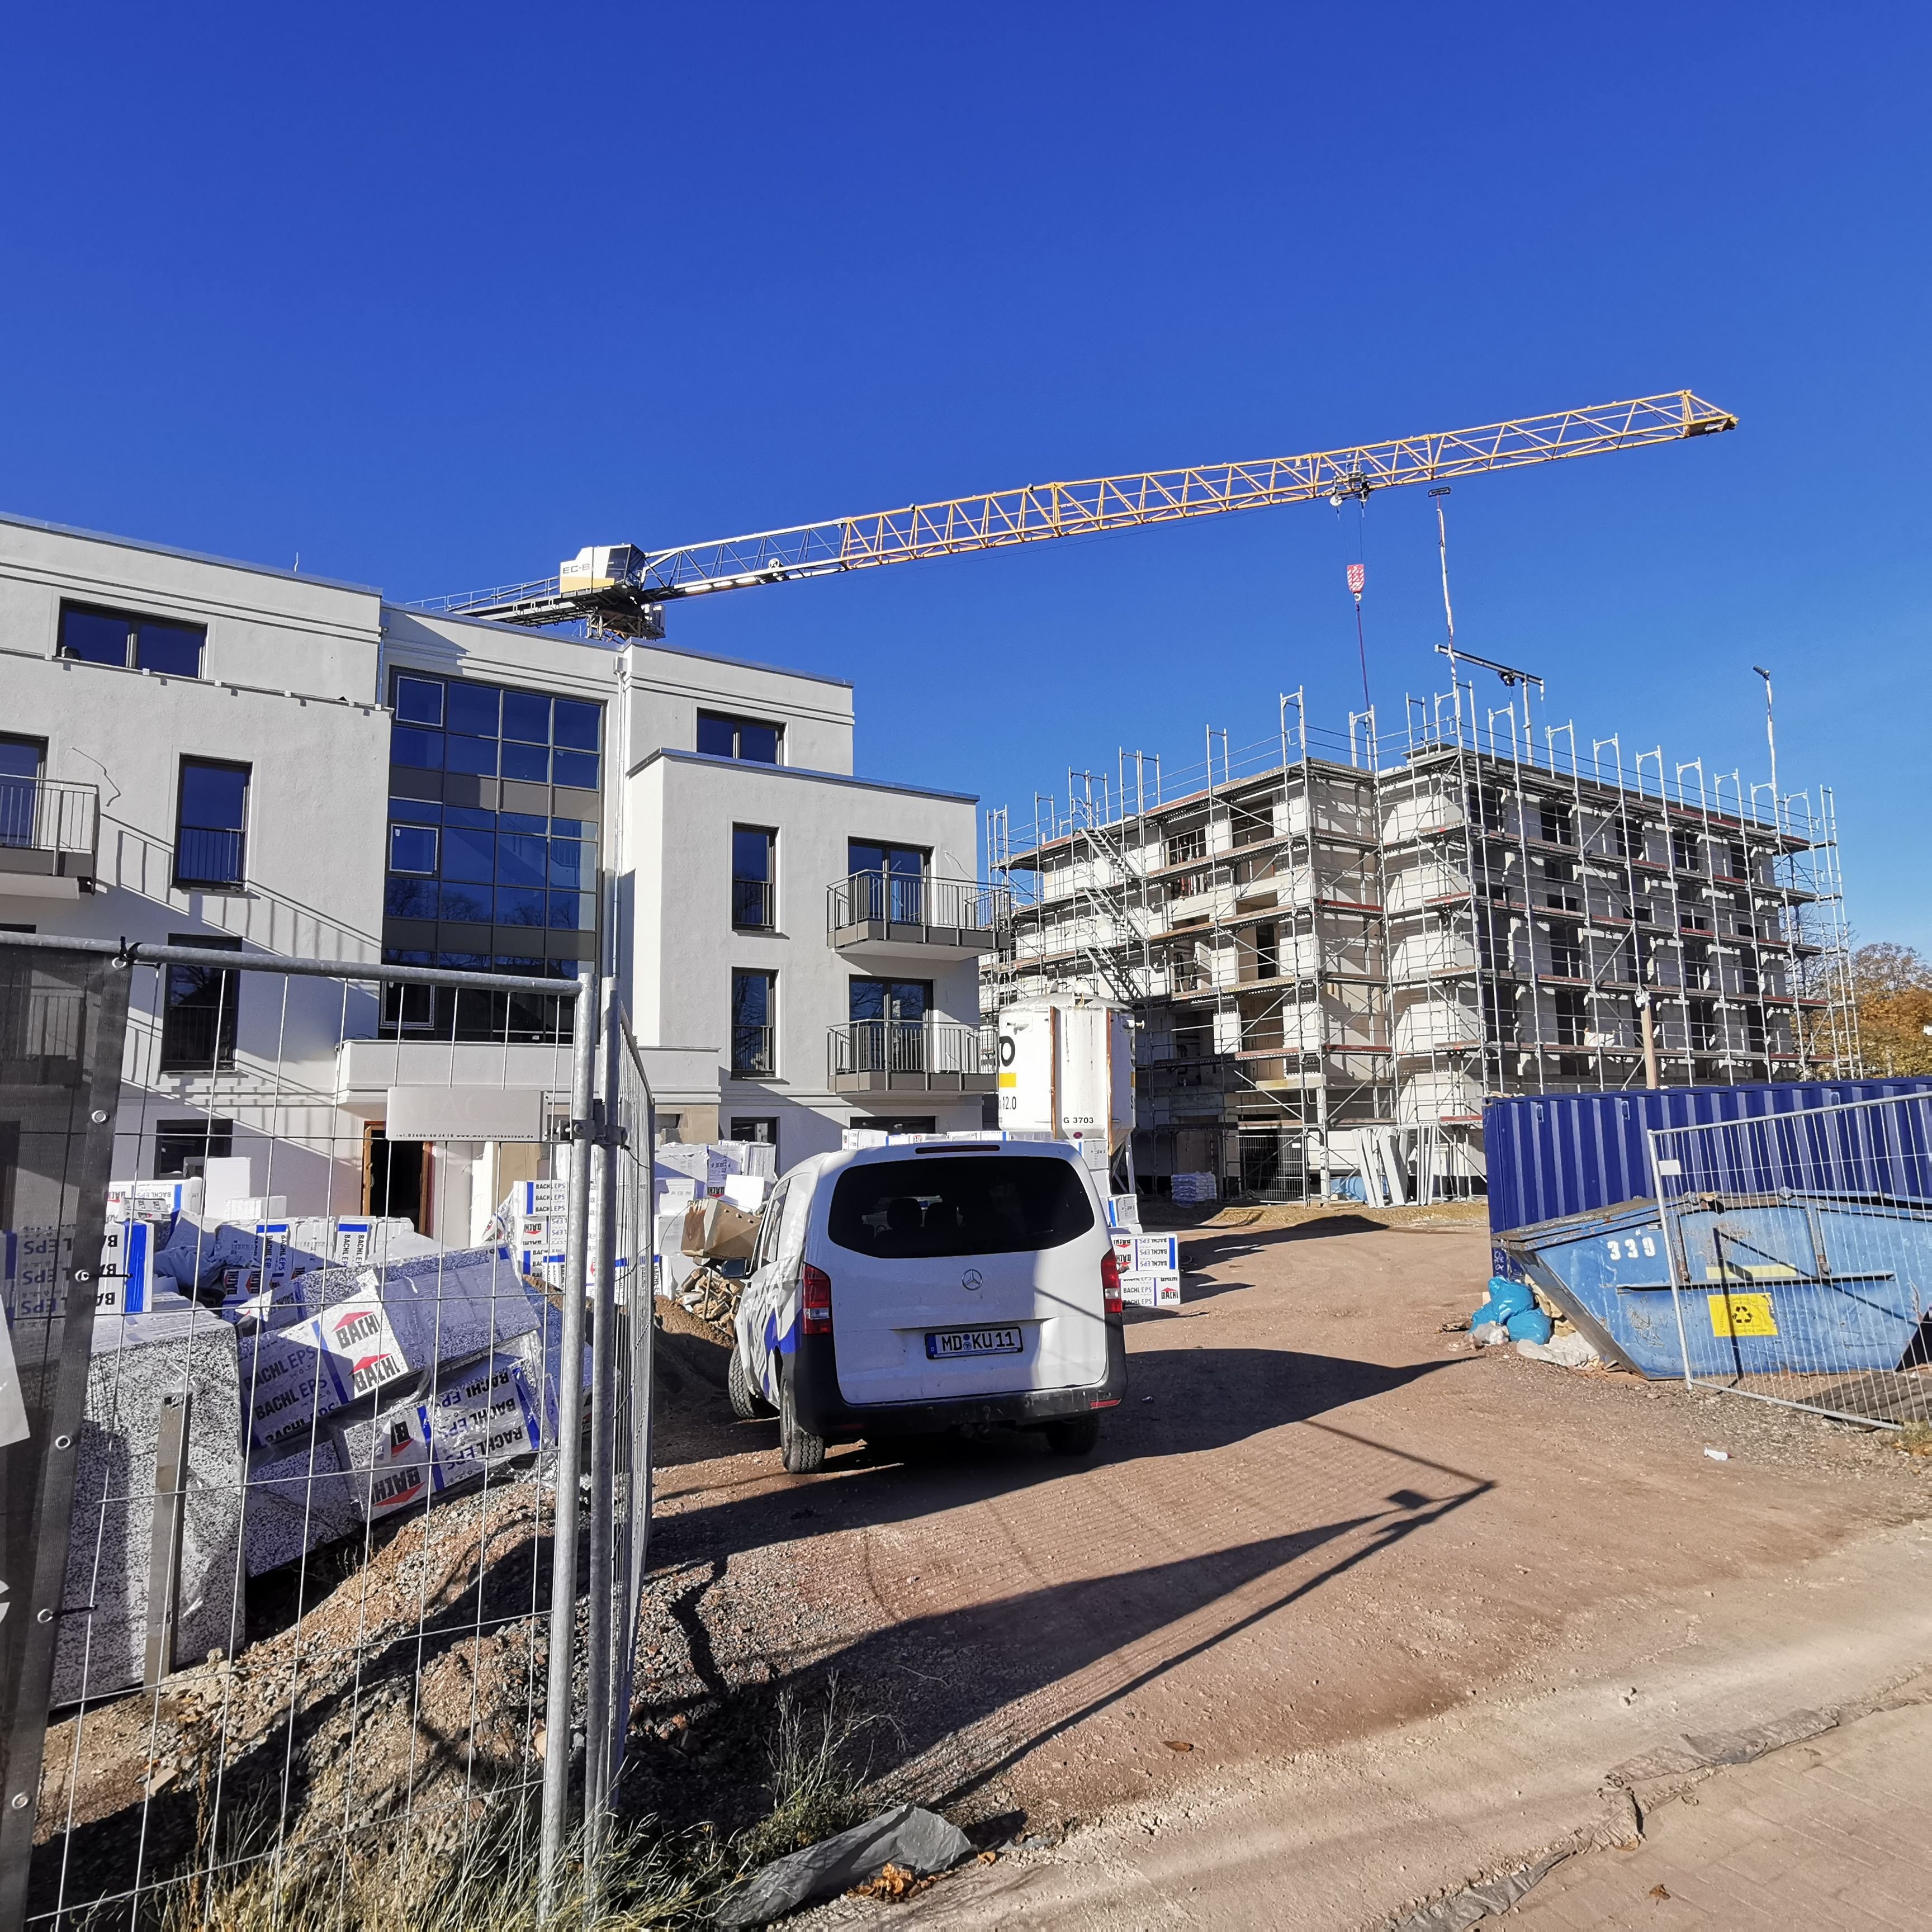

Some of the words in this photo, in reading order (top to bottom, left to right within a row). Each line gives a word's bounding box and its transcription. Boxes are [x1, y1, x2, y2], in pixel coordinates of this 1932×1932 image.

[342, 1234, 351, 1256] BACHL
[356, 1234, 364, 1256] BACHL
[941, 1335, 963, 1352] MD
[972, 1332, 993, 1349] KU
[995, 1331, 1015, 1348] 11
[243, 1360, 289, 1392] BACHL
[287, 1345, 316, 1370] EPS
[253, 1389, 300, 1422] BACHL
[297, 1377, 328, 1399] EPS
